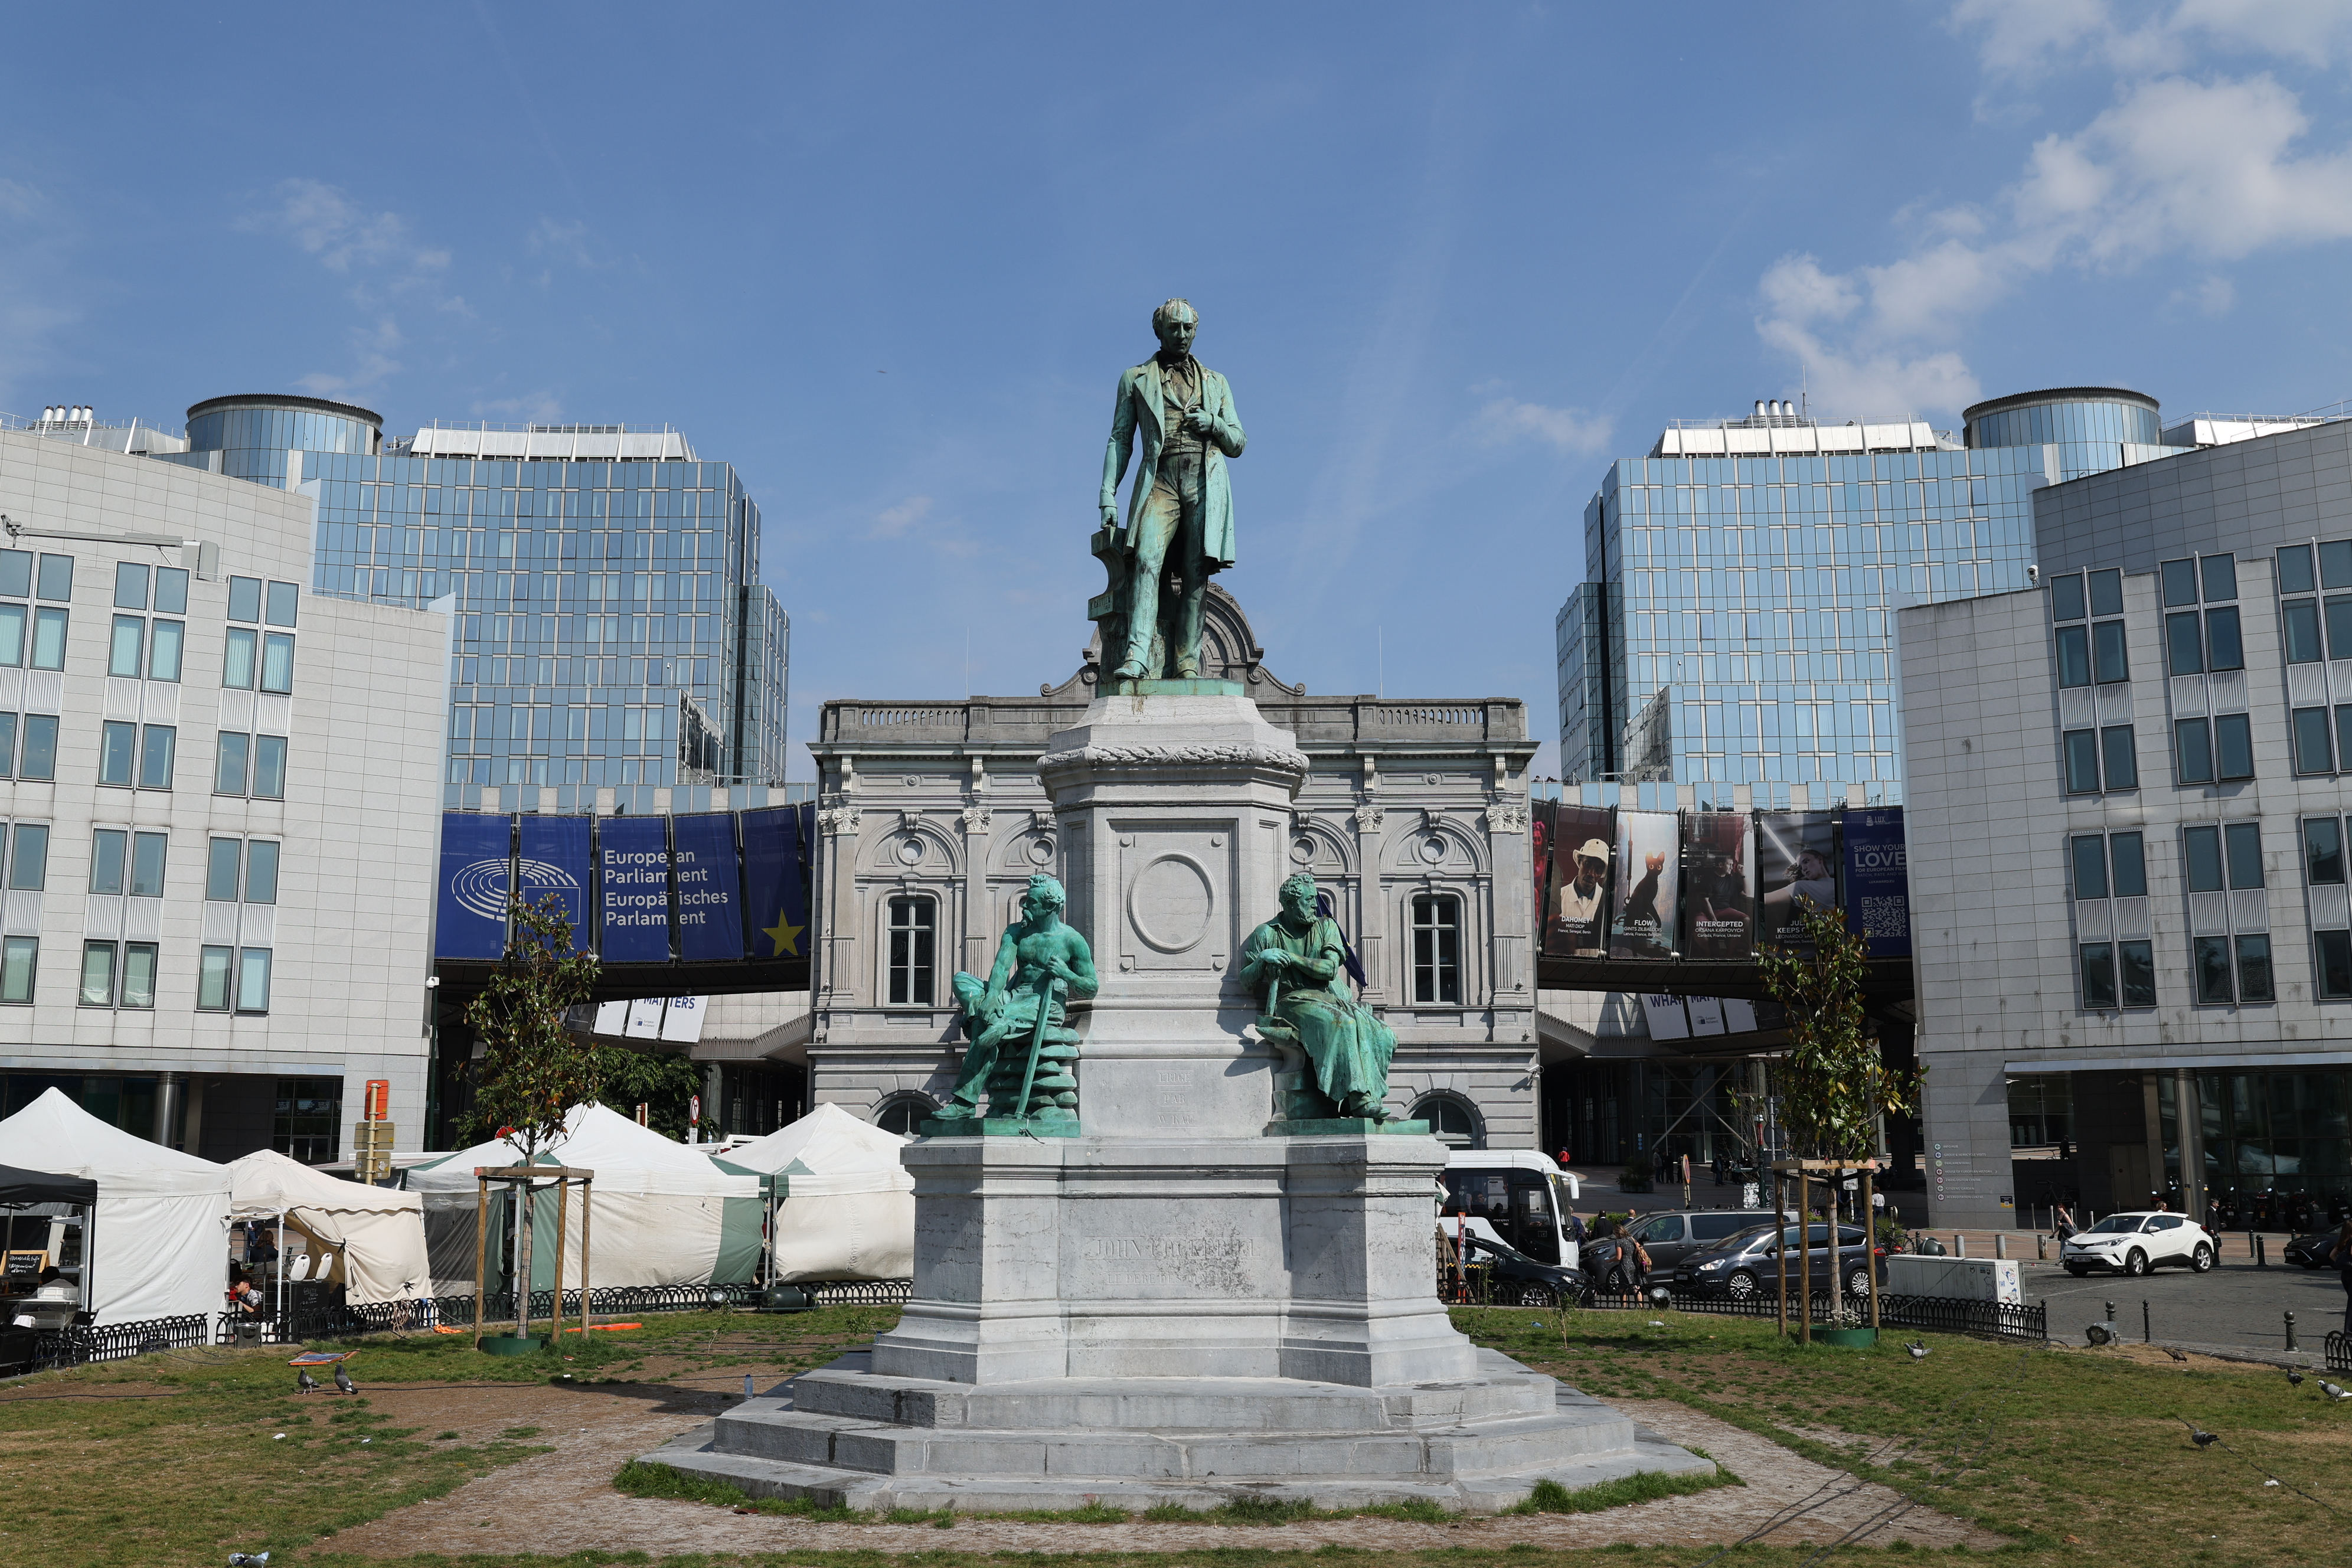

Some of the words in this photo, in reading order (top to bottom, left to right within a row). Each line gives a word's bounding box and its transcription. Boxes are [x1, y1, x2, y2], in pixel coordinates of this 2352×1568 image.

[605, 850, 695, 867] European
[1854, 851, 1907, 867] LOVE
[605, 868, 708, 884] Parliament
[606, 889, 729, 909] Europäisches
[606, 910, 706, 926] Parlament
[1561, 916, 1590, 924] DAHOMEY
[1163, 1093, 1185, 1103] PAR
[1086, 1239, 1142, 1258] JOHN
[1107, 1274, 1122, 1284] LE
[1160, 1274, 1181, 1284] DES
